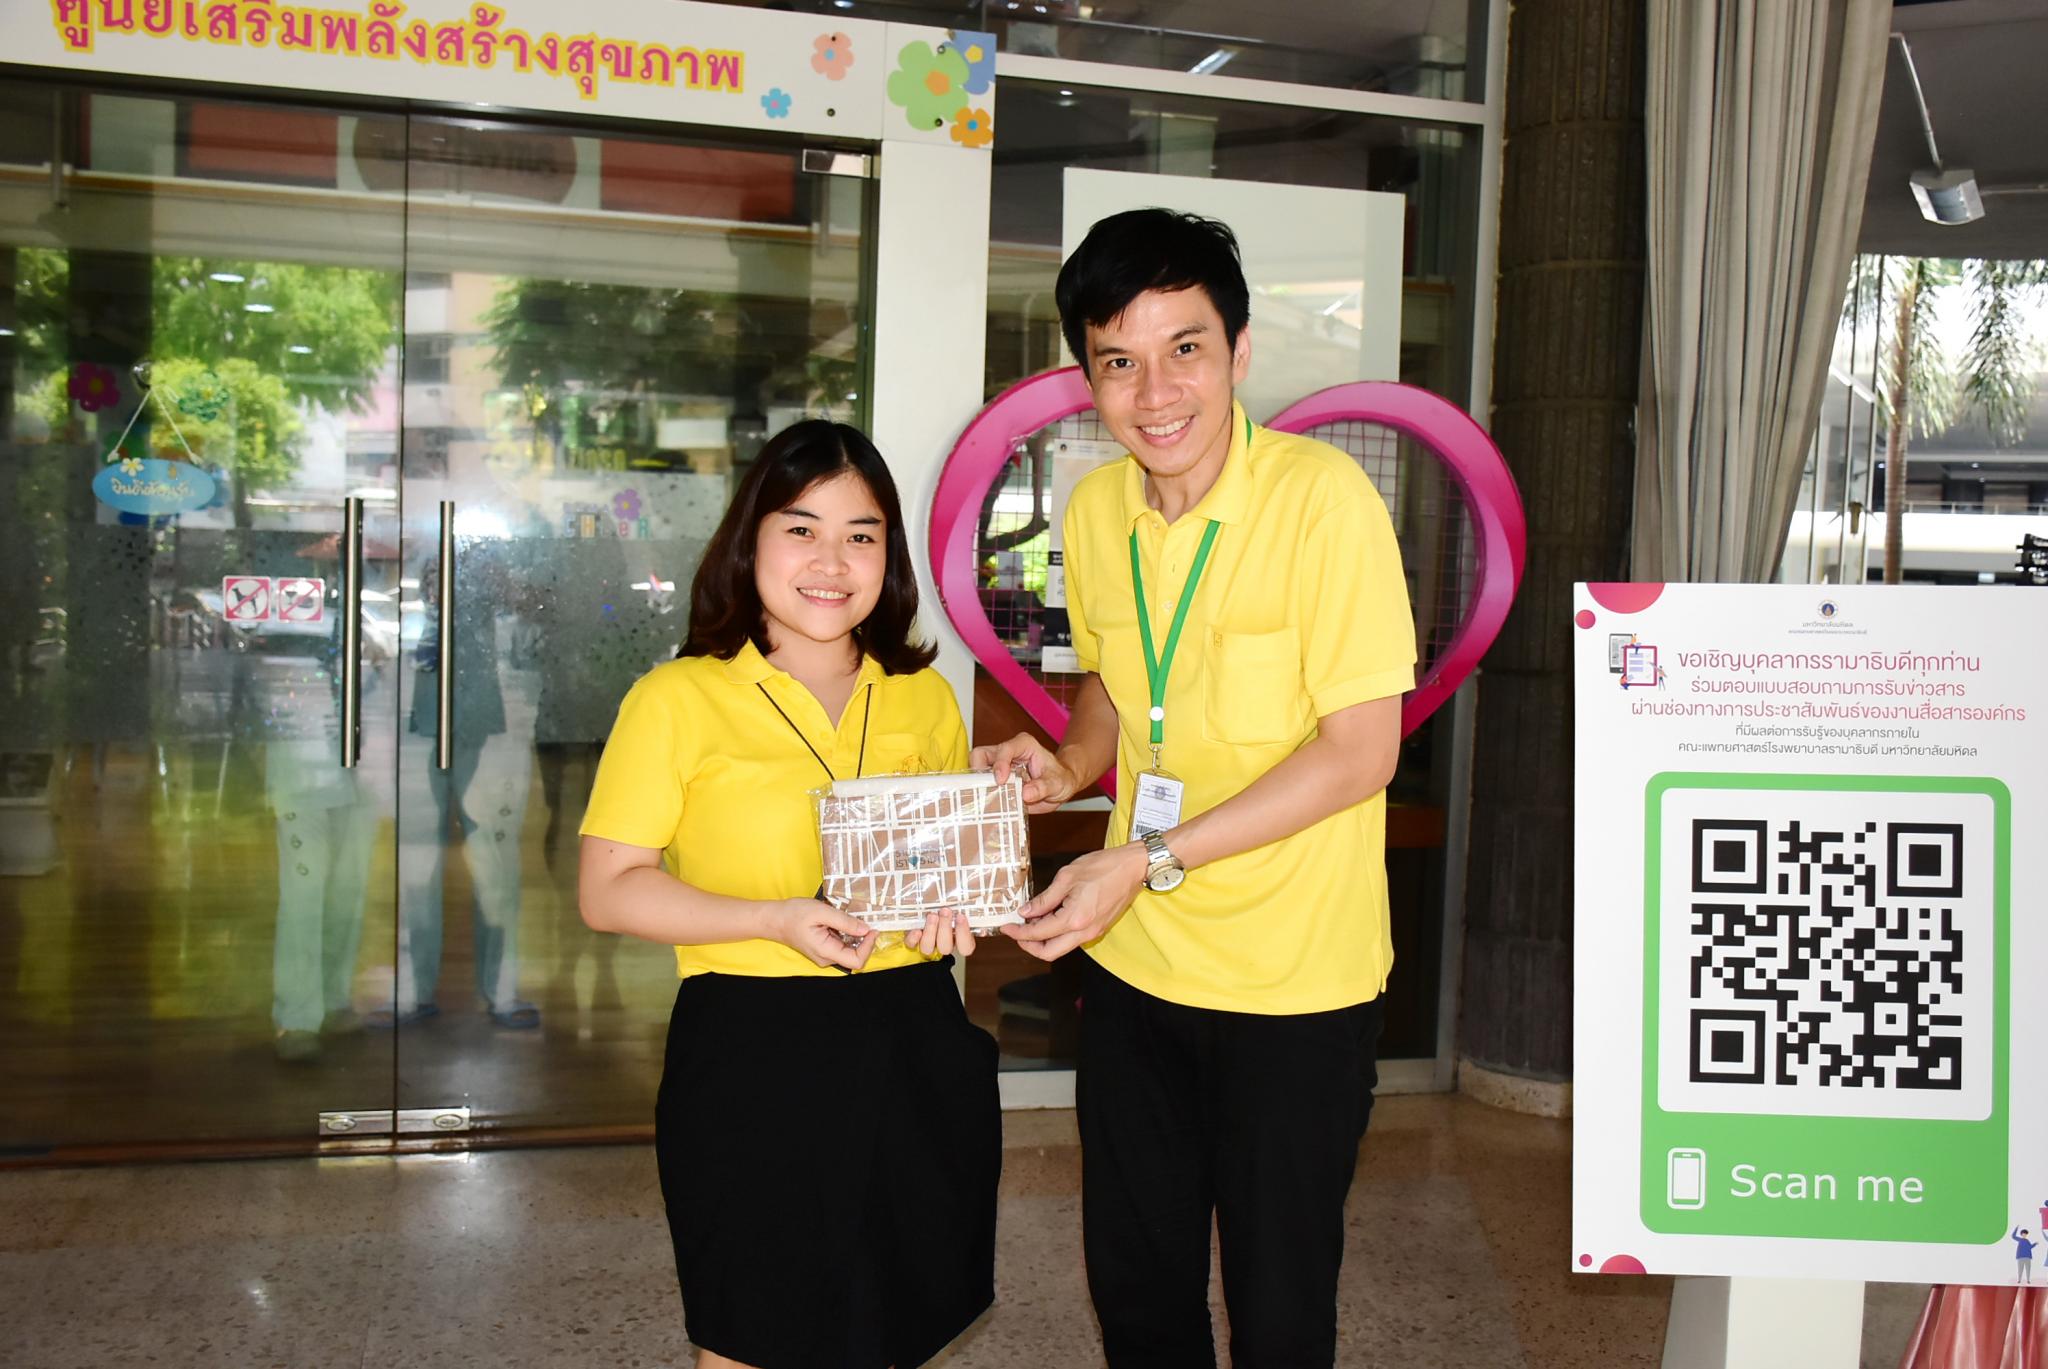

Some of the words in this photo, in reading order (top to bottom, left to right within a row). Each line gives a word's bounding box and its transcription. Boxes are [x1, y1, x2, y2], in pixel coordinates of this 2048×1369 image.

[56, 0, 744, 98] ศูนยเสริมพลังสร้างสุขภาพ
[1678, 649, 1981, 676] ขอเชิญบุคลากรรามาธิบดีทุกท่าน
[1691, 676, 1966, 697] ร่วมตอบแบบสอบถามการรับข่าวสาร
[1632, 697, 2026, 721] ผ่านช่องทางการประชาสัมพันธ์ของงานสื่อสารองค์กร
[1735, 721, 1920, 741] ที่มีผลต่อการรับรู้ของบุคลากรภายใน
[1881, 744, 1978, 757] มหาวิทยาลัยมหิดล
[1730, 1164, 1837, 1201] Scan
[1857, 1176, 1925, 1203] me
